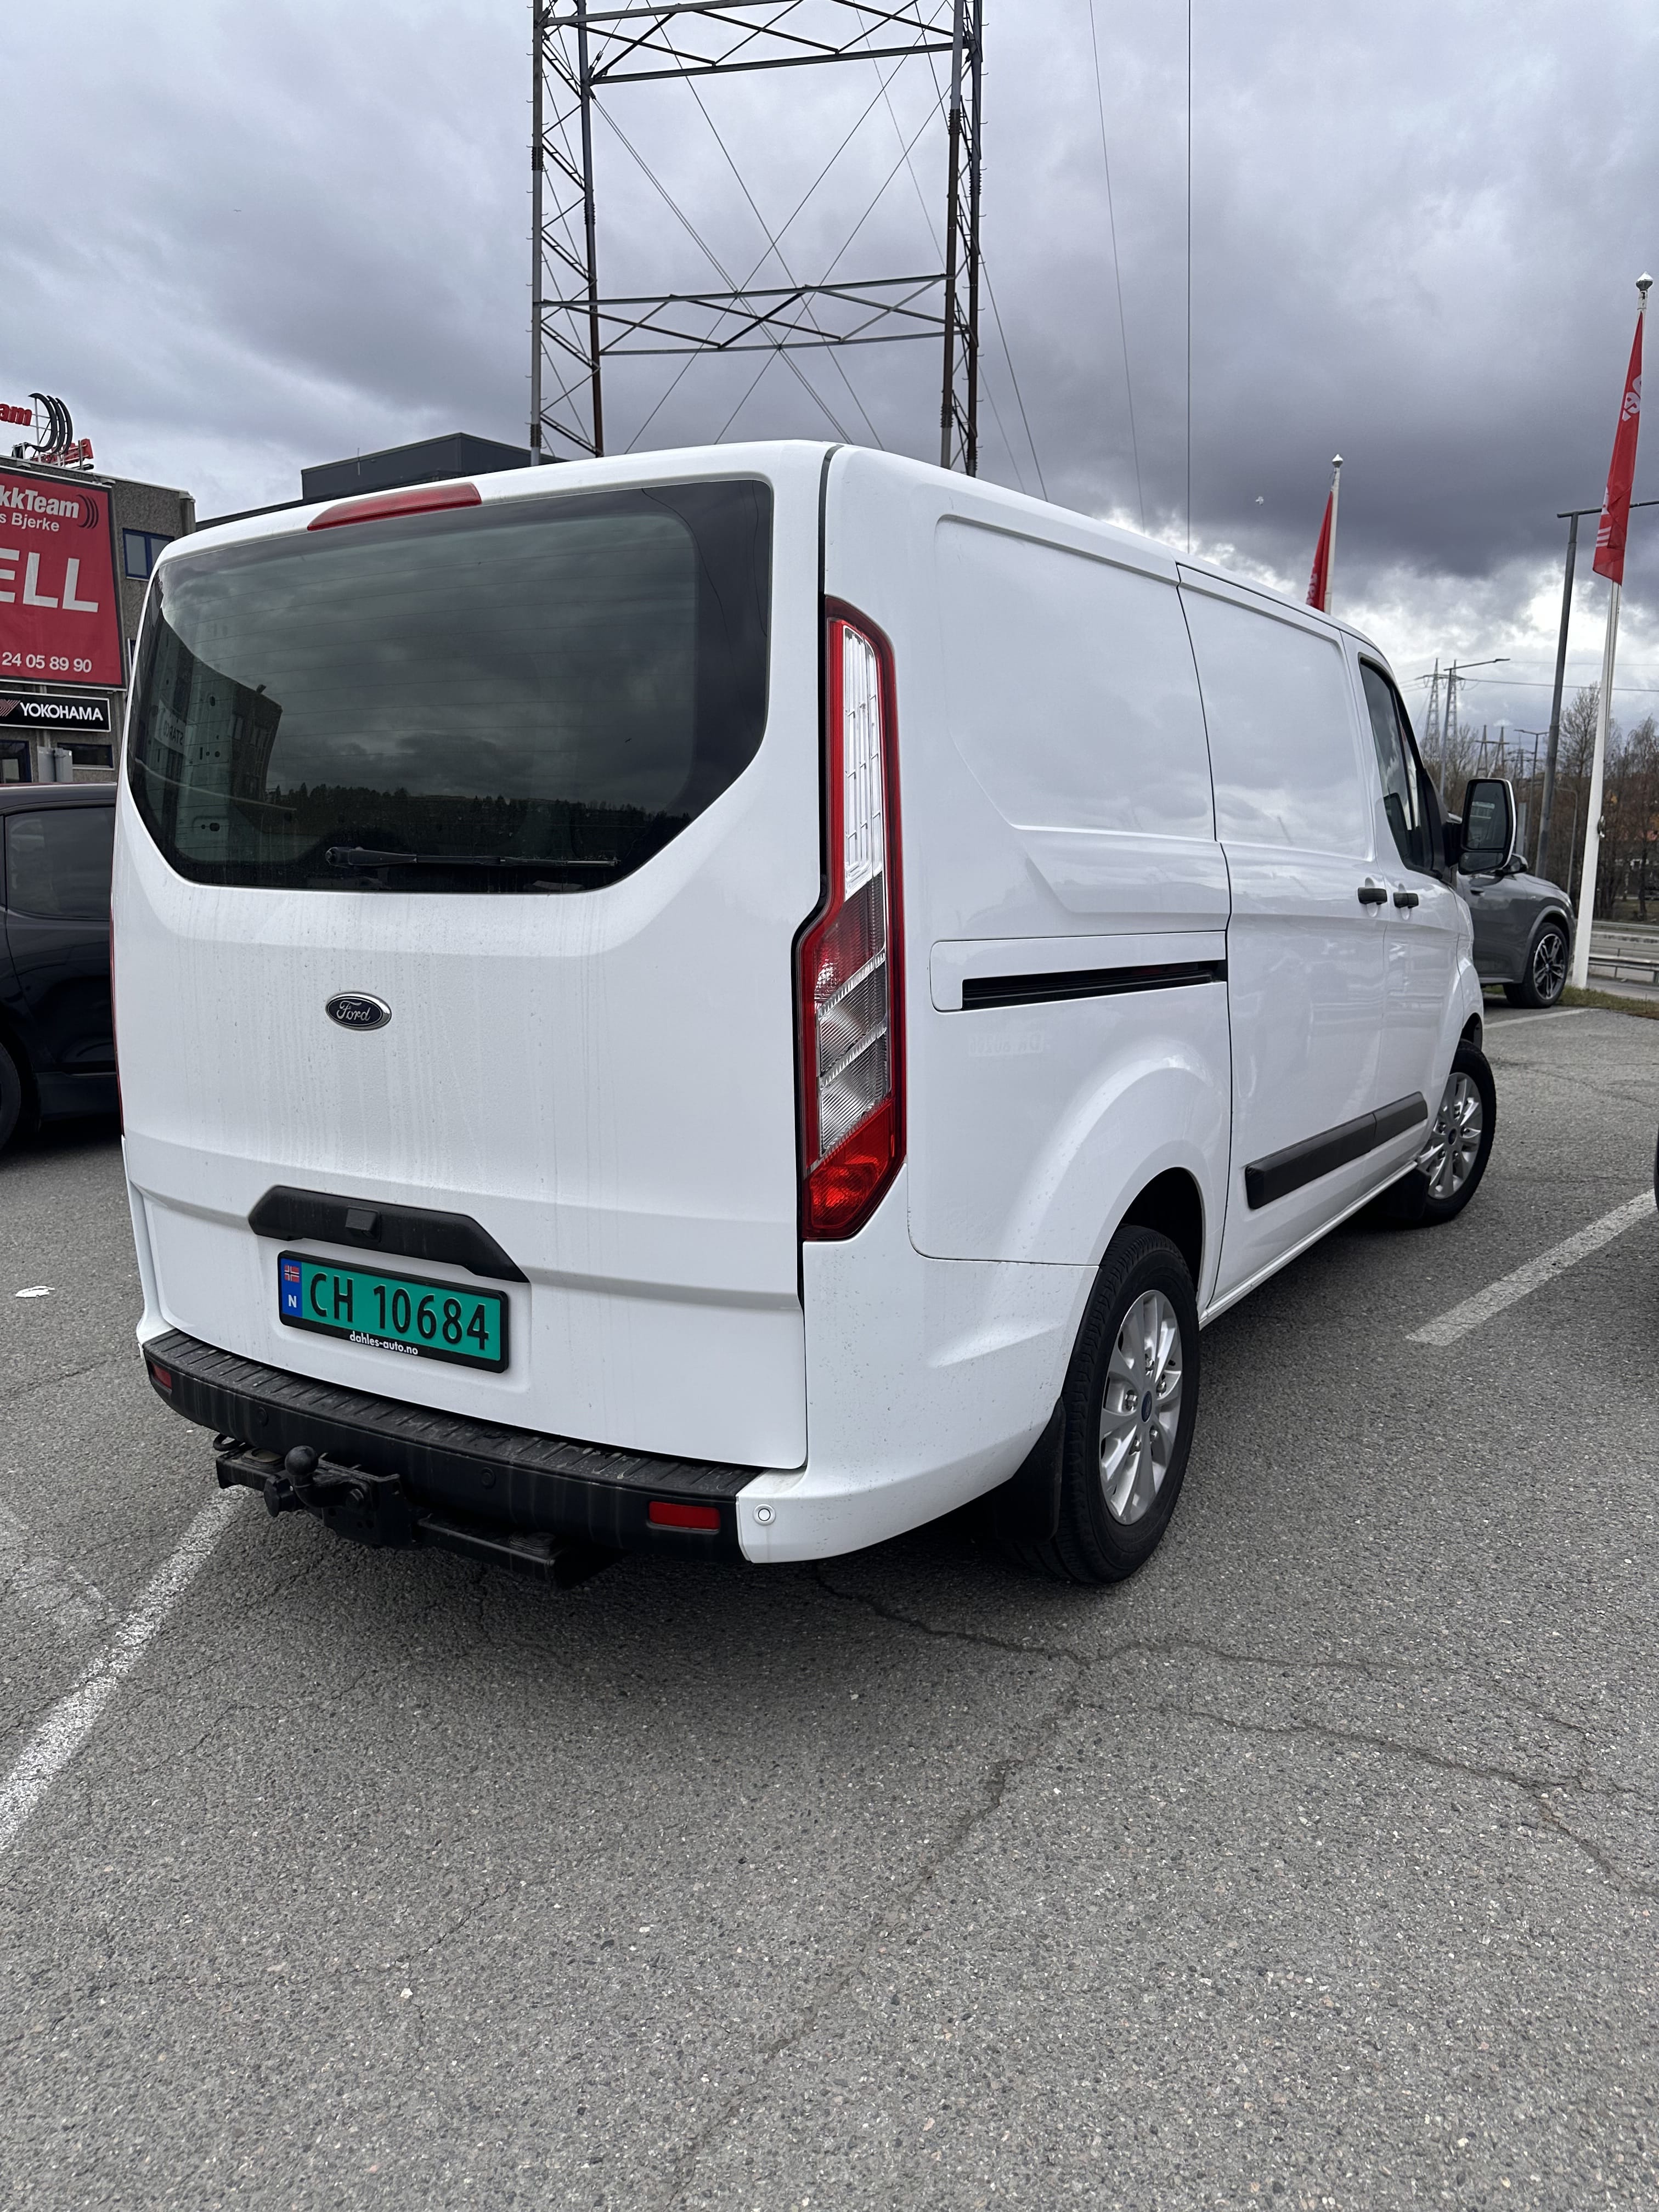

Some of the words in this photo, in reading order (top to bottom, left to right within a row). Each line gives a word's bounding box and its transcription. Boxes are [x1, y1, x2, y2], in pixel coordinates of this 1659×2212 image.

[12, 512, 60, 532] Bjerke
[2, 652, 21, 667] 24
[26, 654, 45, 669] 05
[49, 656, 69, 670] 89
[74, 658, 92, 673] 90
[20, 702, 104, 721] YOKOHAMA
[336, 1000, 371, 1021] Ford
[287, 1294, 297, 1308] N
[310, 1272, 354, 1323] CH
[373, 1284, 489, 1350] 10684
[349, 1330, 419, 1356] dahles-auto.no
